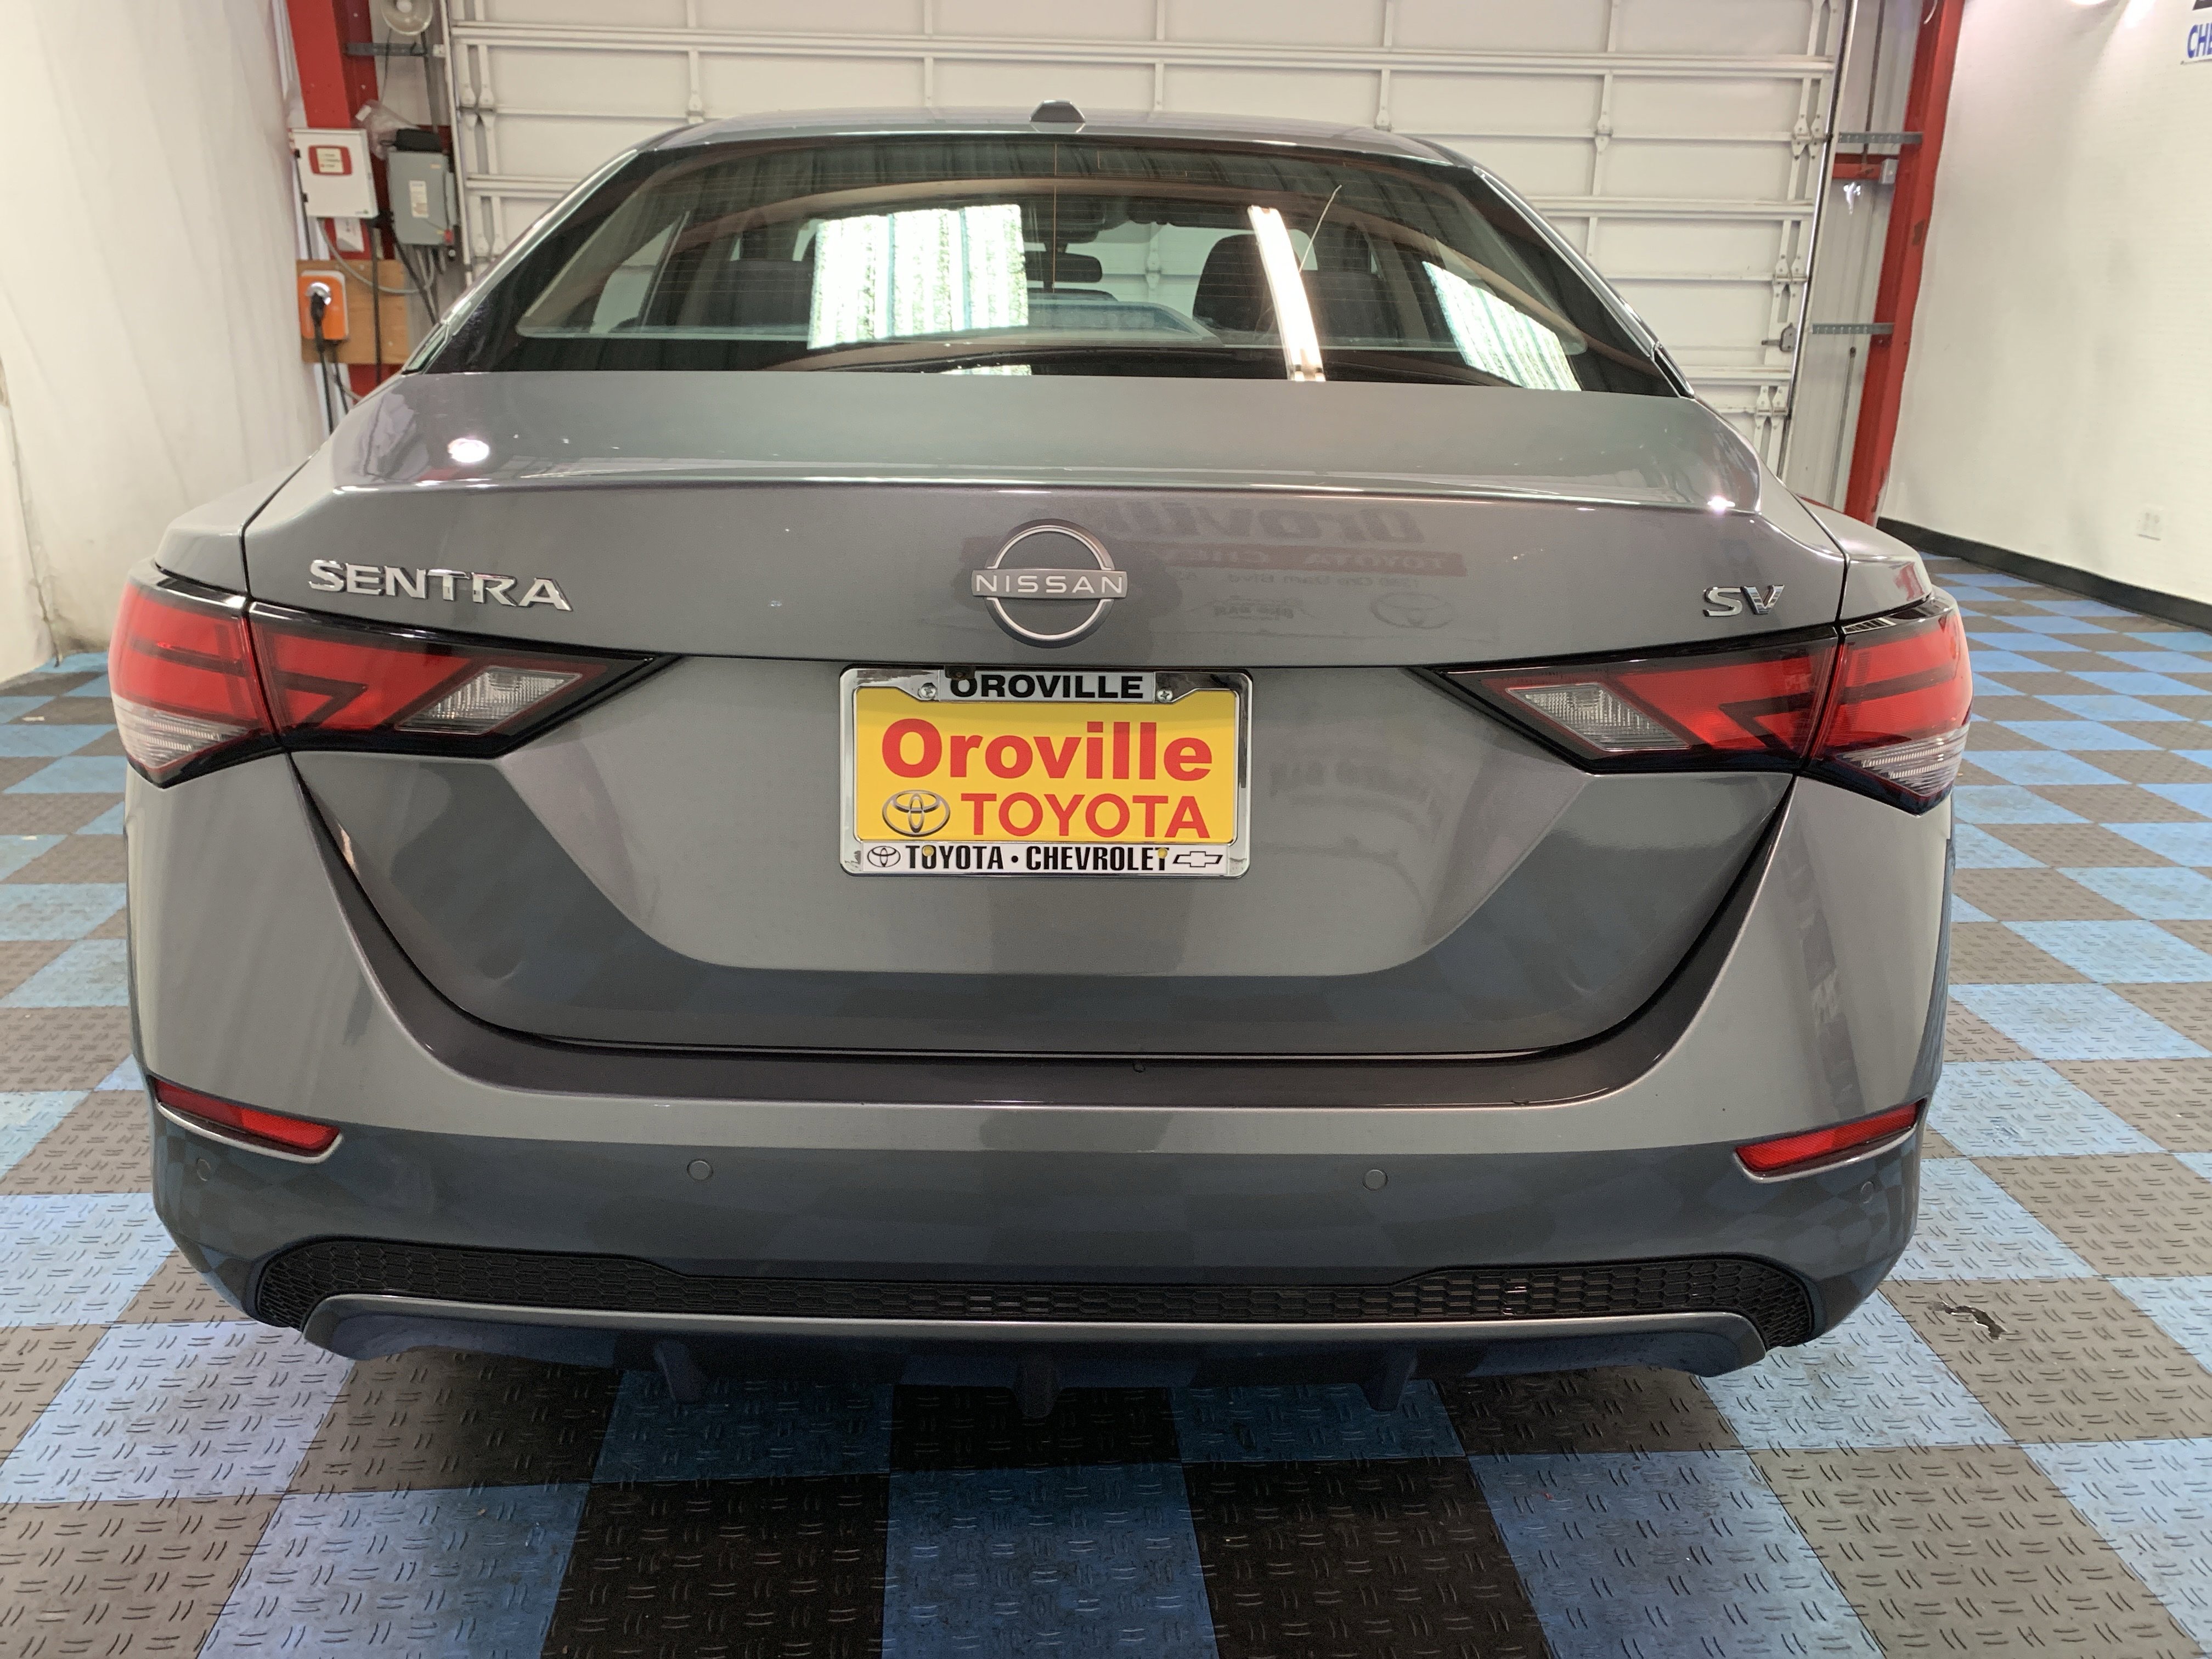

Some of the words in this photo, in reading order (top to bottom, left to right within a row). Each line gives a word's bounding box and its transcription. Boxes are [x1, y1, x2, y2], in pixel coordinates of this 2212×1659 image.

[308, 560, 573, 611] SENTRA
[975, 573, 1124, 594] NISSAN
[1703, 584, 1785, 617] SV
[950, 674, 1144, 699] OROVILLE
[881, 718, 1213, 782] Oroville
[961, 792, 1210, 838] TOYOTA
[905, 845, 1005, 870] TOYOTA
[1026, 845, 1170, 871] CHEVROLET
